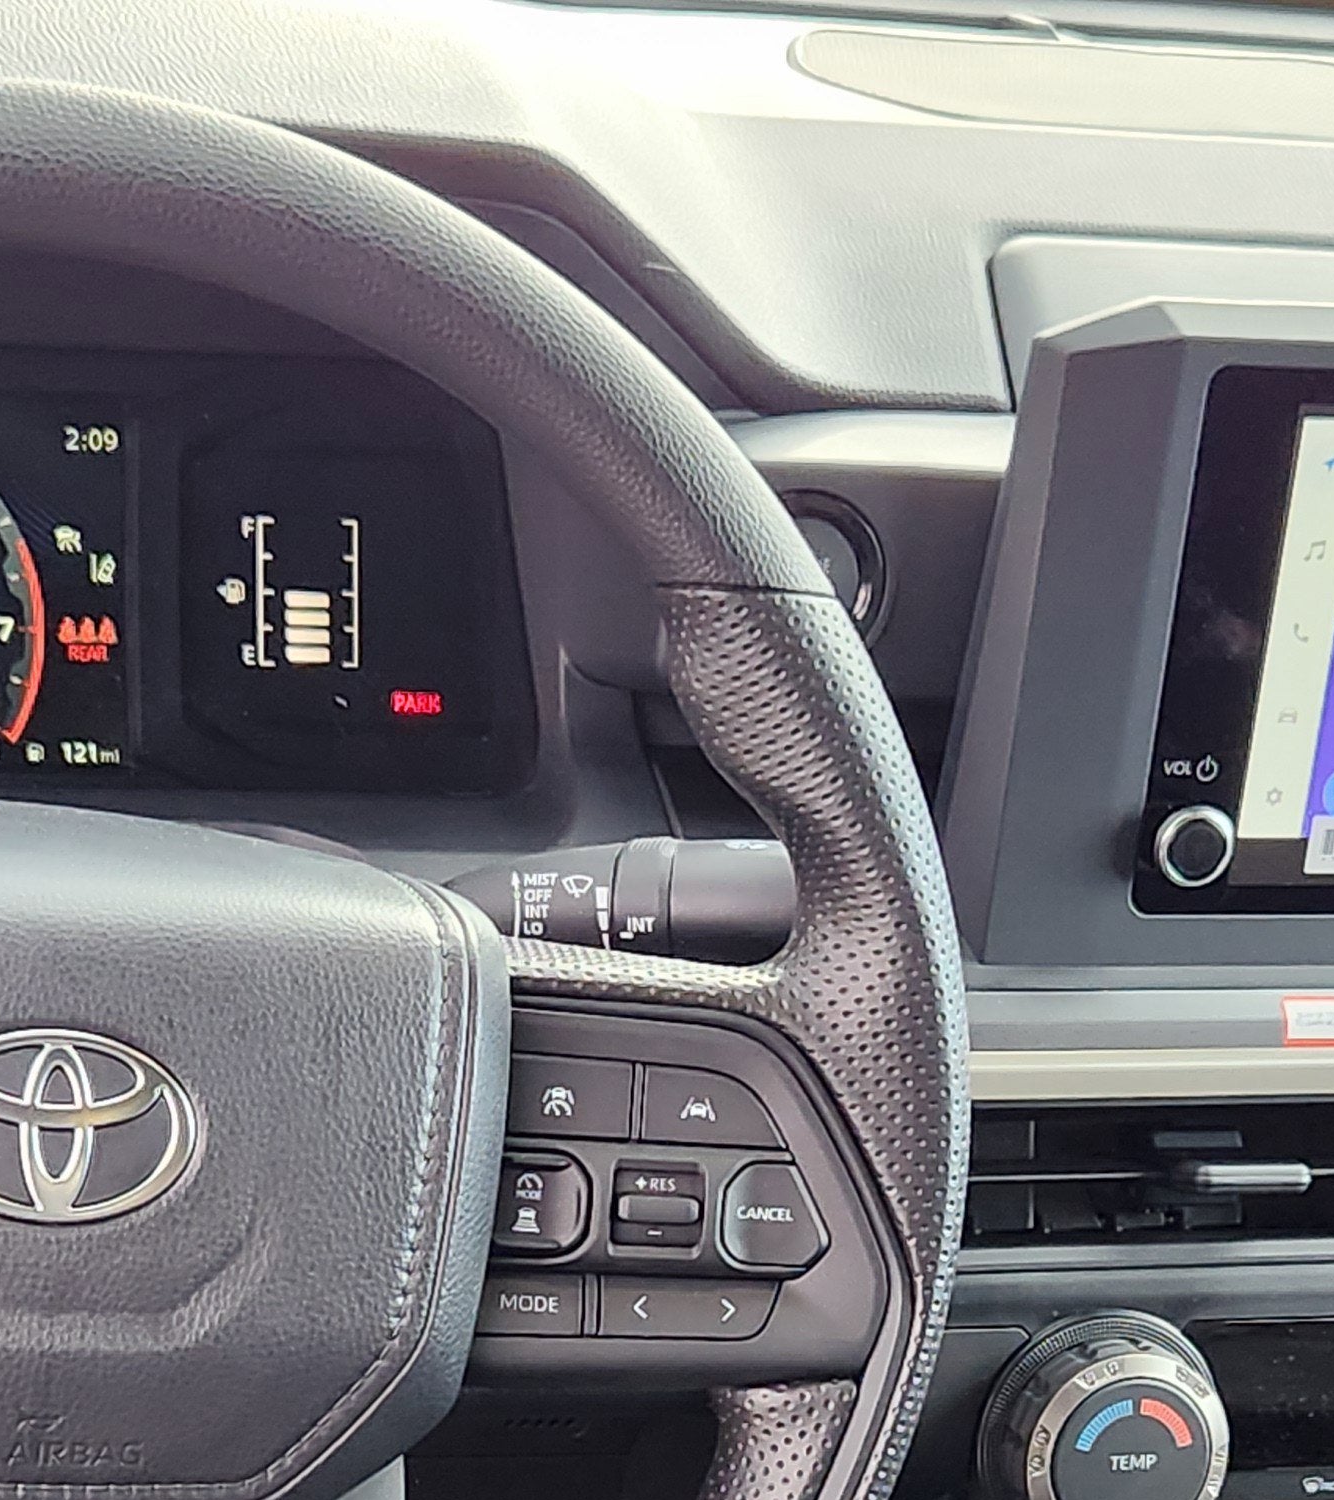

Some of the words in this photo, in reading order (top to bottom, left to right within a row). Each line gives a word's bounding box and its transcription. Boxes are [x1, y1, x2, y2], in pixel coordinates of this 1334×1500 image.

[64, 427, 120, 452] 2:09
[240, 515, 255, 538] F
[68, 645, 109, 662] REAR
[240, 644, 256, 666] E
[391, 691, 442, 715] PARK
[1164, 760, 1192, 776] VOL
[524, 873, 558, 887] MIST
[524, 890, 552, 903] OFF
[525, 904, 550, 919] INT
[524, 920, 544, 935] LO
[627, 916, 656, 933] INT
[737, 1205, 794, 1223] CANCEL
[500, 1293, 560, 1314] MODE
[6, 1439, 146, 1468] AIRBAG
[1109, 1454, 1158, 1471] TEMP
